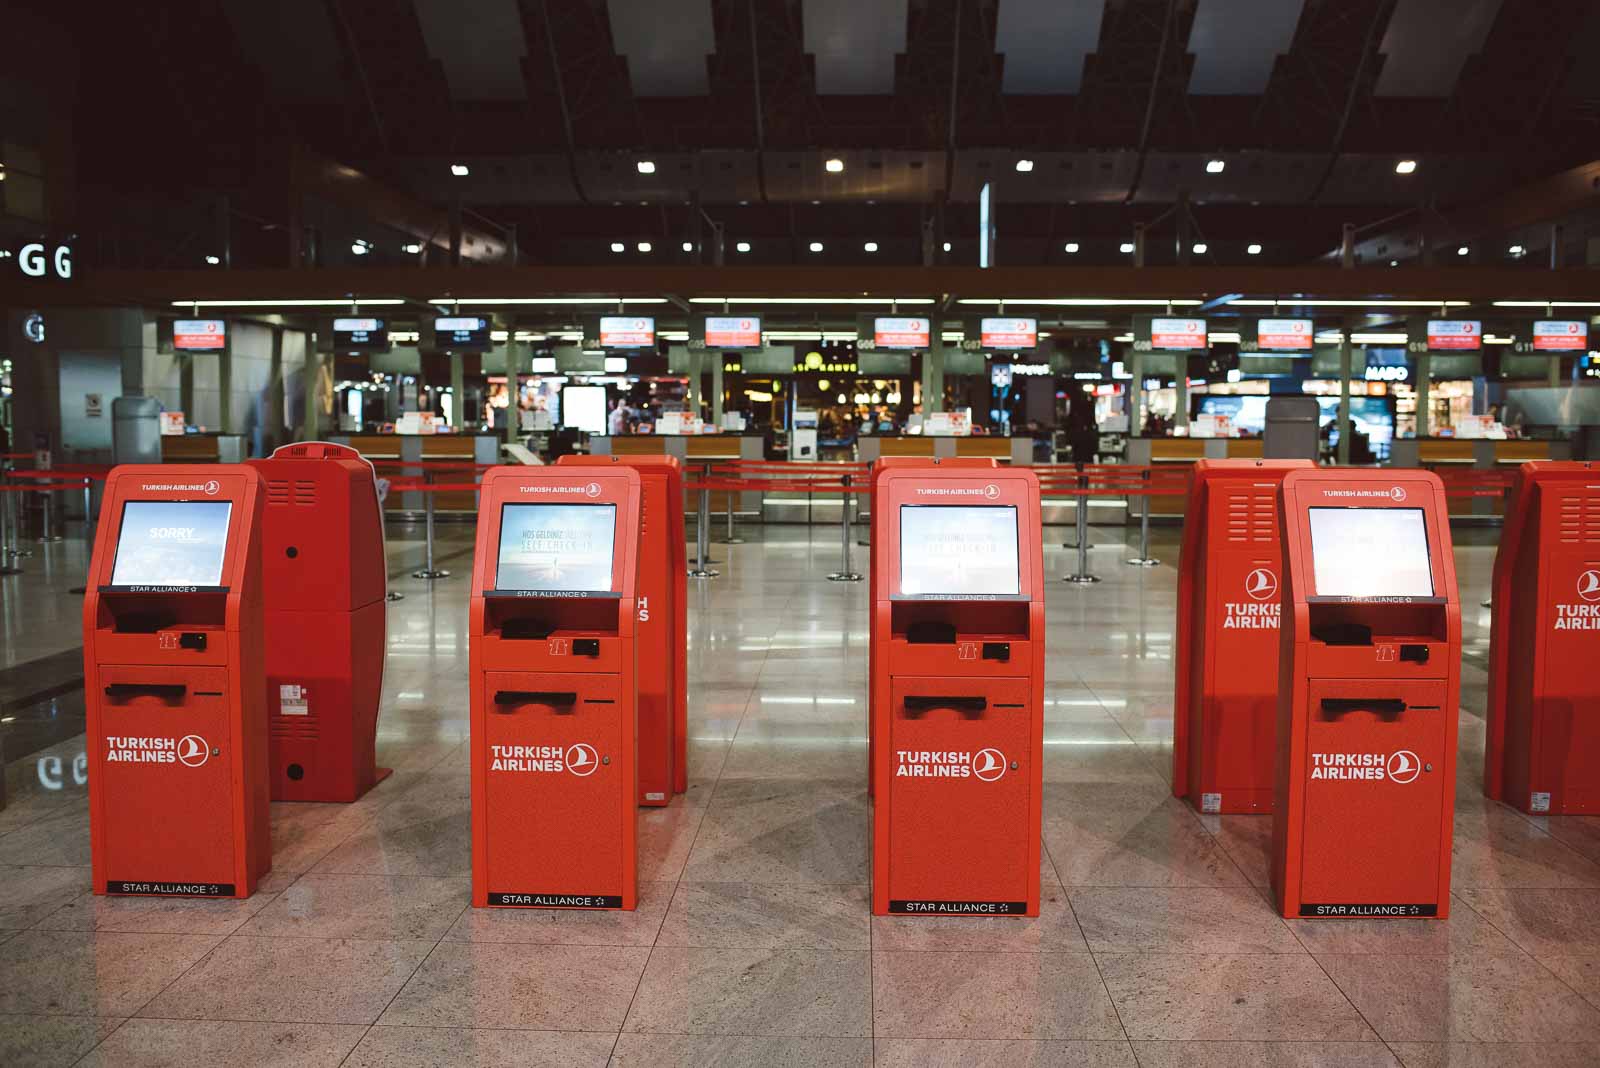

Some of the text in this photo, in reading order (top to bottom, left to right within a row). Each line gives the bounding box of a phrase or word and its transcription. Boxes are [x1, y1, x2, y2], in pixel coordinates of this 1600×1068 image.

[19, 243, 46, 277] G
[54, 245, 72, 279] G
[149, 527, 195, 538] SORRY
[1224, 616, 1281, 629] AIRLIN
[106, 736, 175, 750] TURKISH
[107, 750, 176, 763] AIRLINES
[491, 745, 563, 759] TURKISH
[896, 751, 970, 764] TURKISH
[491, 759, 564, 772] AIRLINES
[1312, 753, 1385, 766] TURKISH
[896, 764, 971, 777] AIRLINES
[1311, 767, 1385, 780] AIRLINES
[122, 883, 206, 894] STAR ALLIANCE
[502, 895, 592, 906] STAR ALLIANCE
[906, 902, 996, 912] STAR ALLIANCE
[1317, 906, 1406, 915] STAR ALLIANCE
